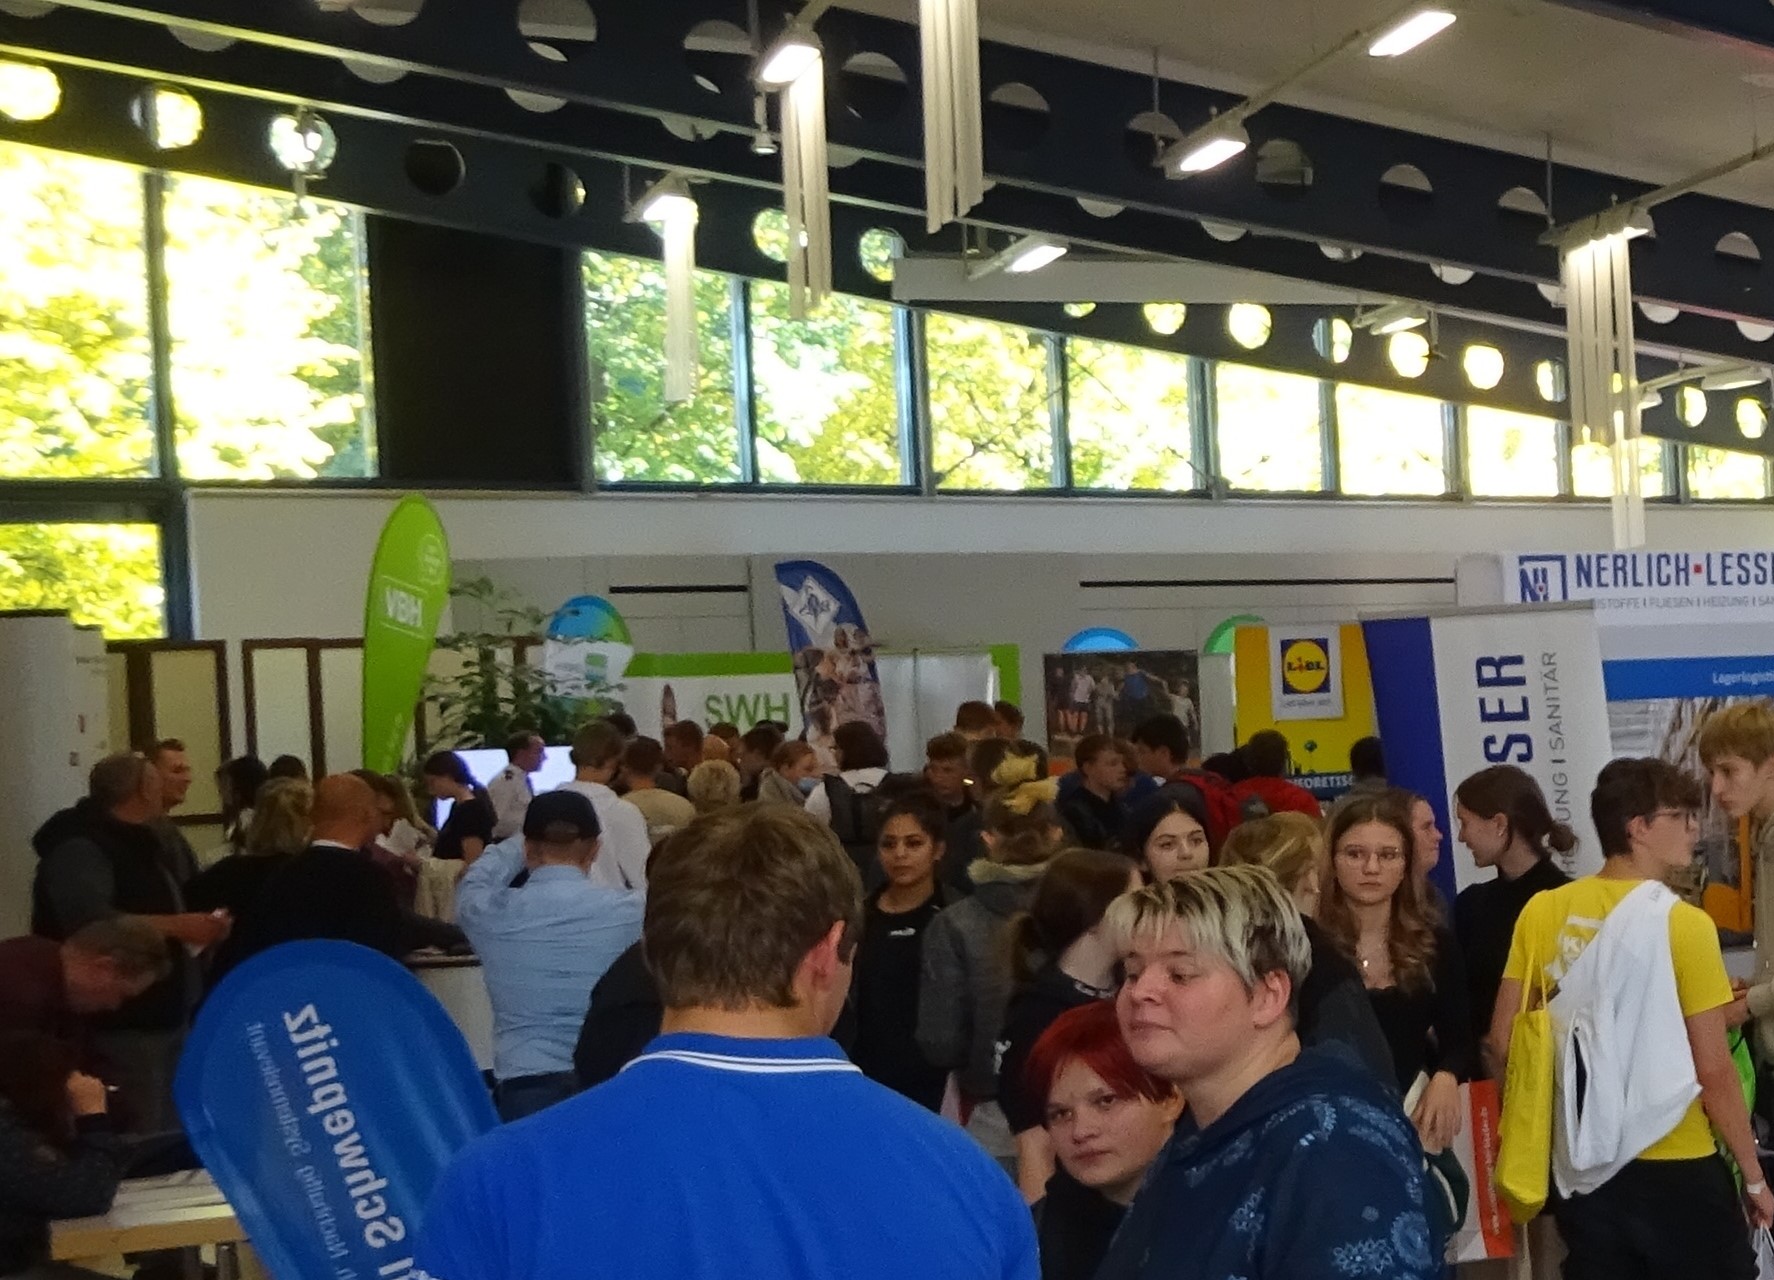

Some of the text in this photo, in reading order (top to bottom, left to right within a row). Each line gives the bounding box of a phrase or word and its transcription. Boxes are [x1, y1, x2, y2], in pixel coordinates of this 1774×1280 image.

[1575, 552, 1690, 588] NERLICH
[704, 692, 790, 728] SWH
[1475, 654, 1534, 763] SER
[1541, 651, 1580, 877] HEUNG SANITÄR
